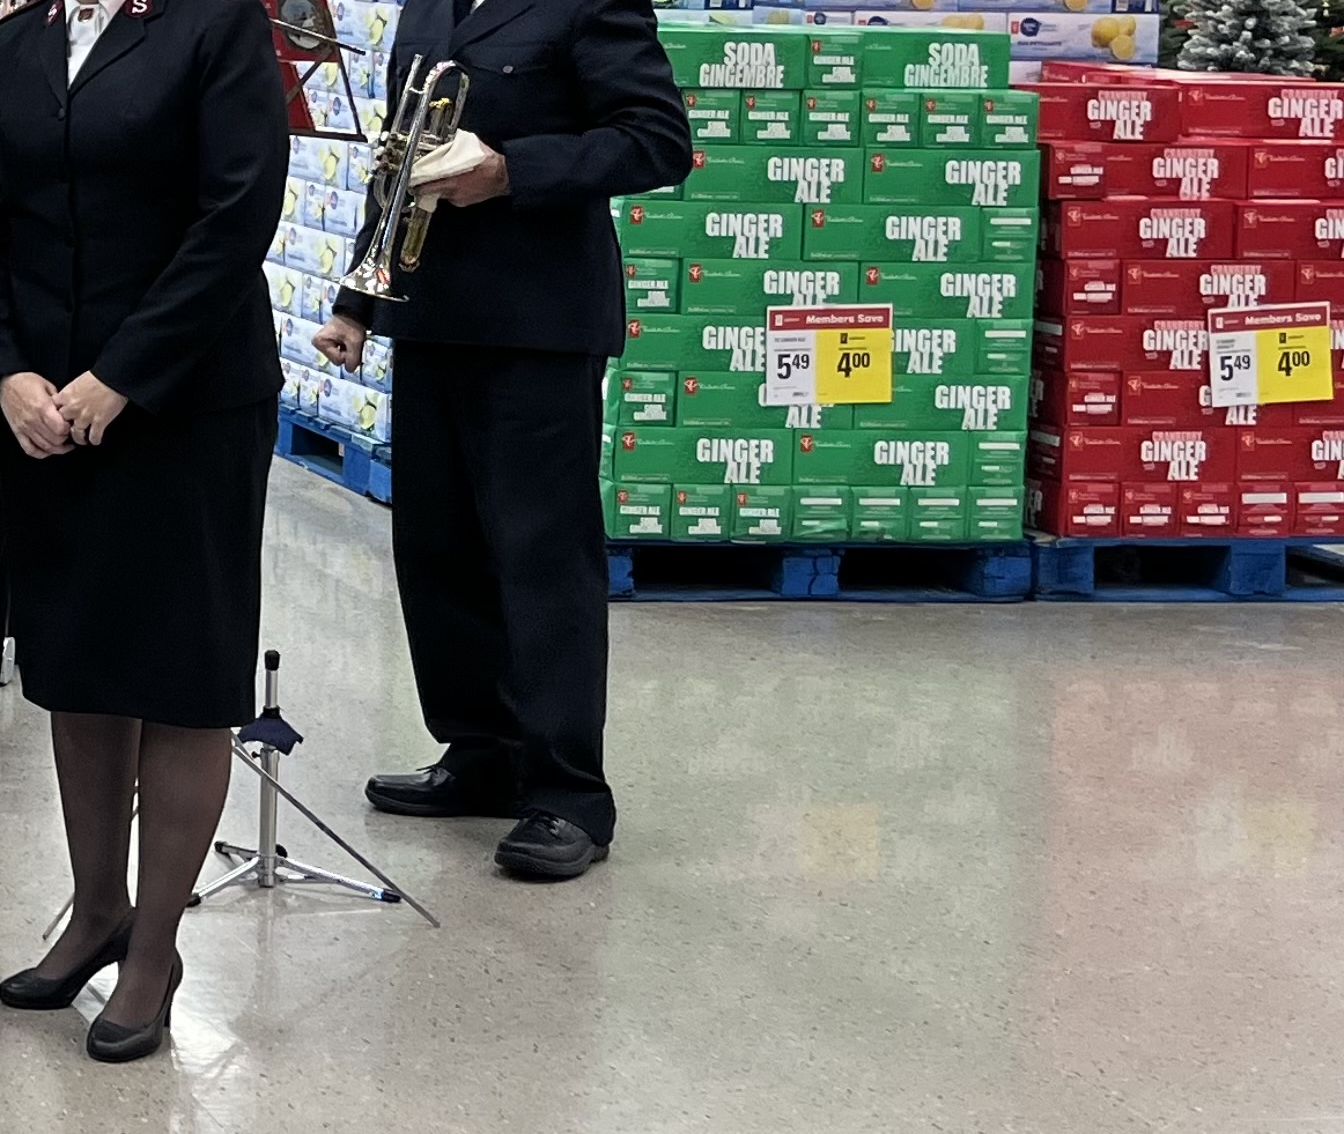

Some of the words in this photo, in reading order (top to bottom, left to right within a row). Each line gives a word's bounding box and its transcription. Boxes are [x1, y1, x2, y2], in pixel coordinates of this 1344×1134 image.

[723, 41, 776, 66] SODA
[928, 42, 980, 66] SODA
[699, 63, 784, 88] GINGEMBRE
[904, 64, 989, 88] GINGEMBRE
[1086, 98, 1152, 121] GINGER
[1267, 97, 1343, 121] GINGER
[1113, 119, 1144, 140] ALE
[1298, 118, 1335, 138] ALE
[767, 157, 845, 183] GINGER
[945, 160, 1022, 185] GINGER
[1151, 157, 1219, 179] GINGER
[794, 180, 831, 204] ALE
[971, 183, 1008, 206] ALE
[1179, 177, 1211, 200] ALE
[705, 212, 783, 238] GINGER
[885, 215, 962, 240] GINGER
[1139, 217, 1206, 239] GINGER
[732, 236, 769, 258] ALE
[912, 239, 948, 262] ALE
[1166, 237, 1197, 258] ALE
[763, 270, 840, 296] GINGER
[940, 272, 1017, 298] GINGER
[1199, 273, 1266, 296] GINGER
[805, 314, 855, 325] Members
[857, 313, 885, 324] Save
[966, 296, 1003, 319] ALE
[1244, 314, 1294, 326] Members
[1295, 312, 1322, 323] Save
[702, 325, 767, 351] GINGE
[892, 328, 957, 353] INGER
[907, 351, 943, 374] ALE
[1169, 350, 1202, 370] ALE
[935, 385, 1012, 409] GINGER
[785, 405, 823, 429] ALE
[961, 408, 998, 431] ALE
[1224, 407, 1257, 426] ALE
[695, 438, 774, 464] GINGER
[874, 440, 950, 466] GINGER
[1141, 440, 1207, 462] GINGER
[724, 462, 761, 484] ALE
[900, 464, 936, 486] ALE
[1167, 460, 1199, 481] ALE
